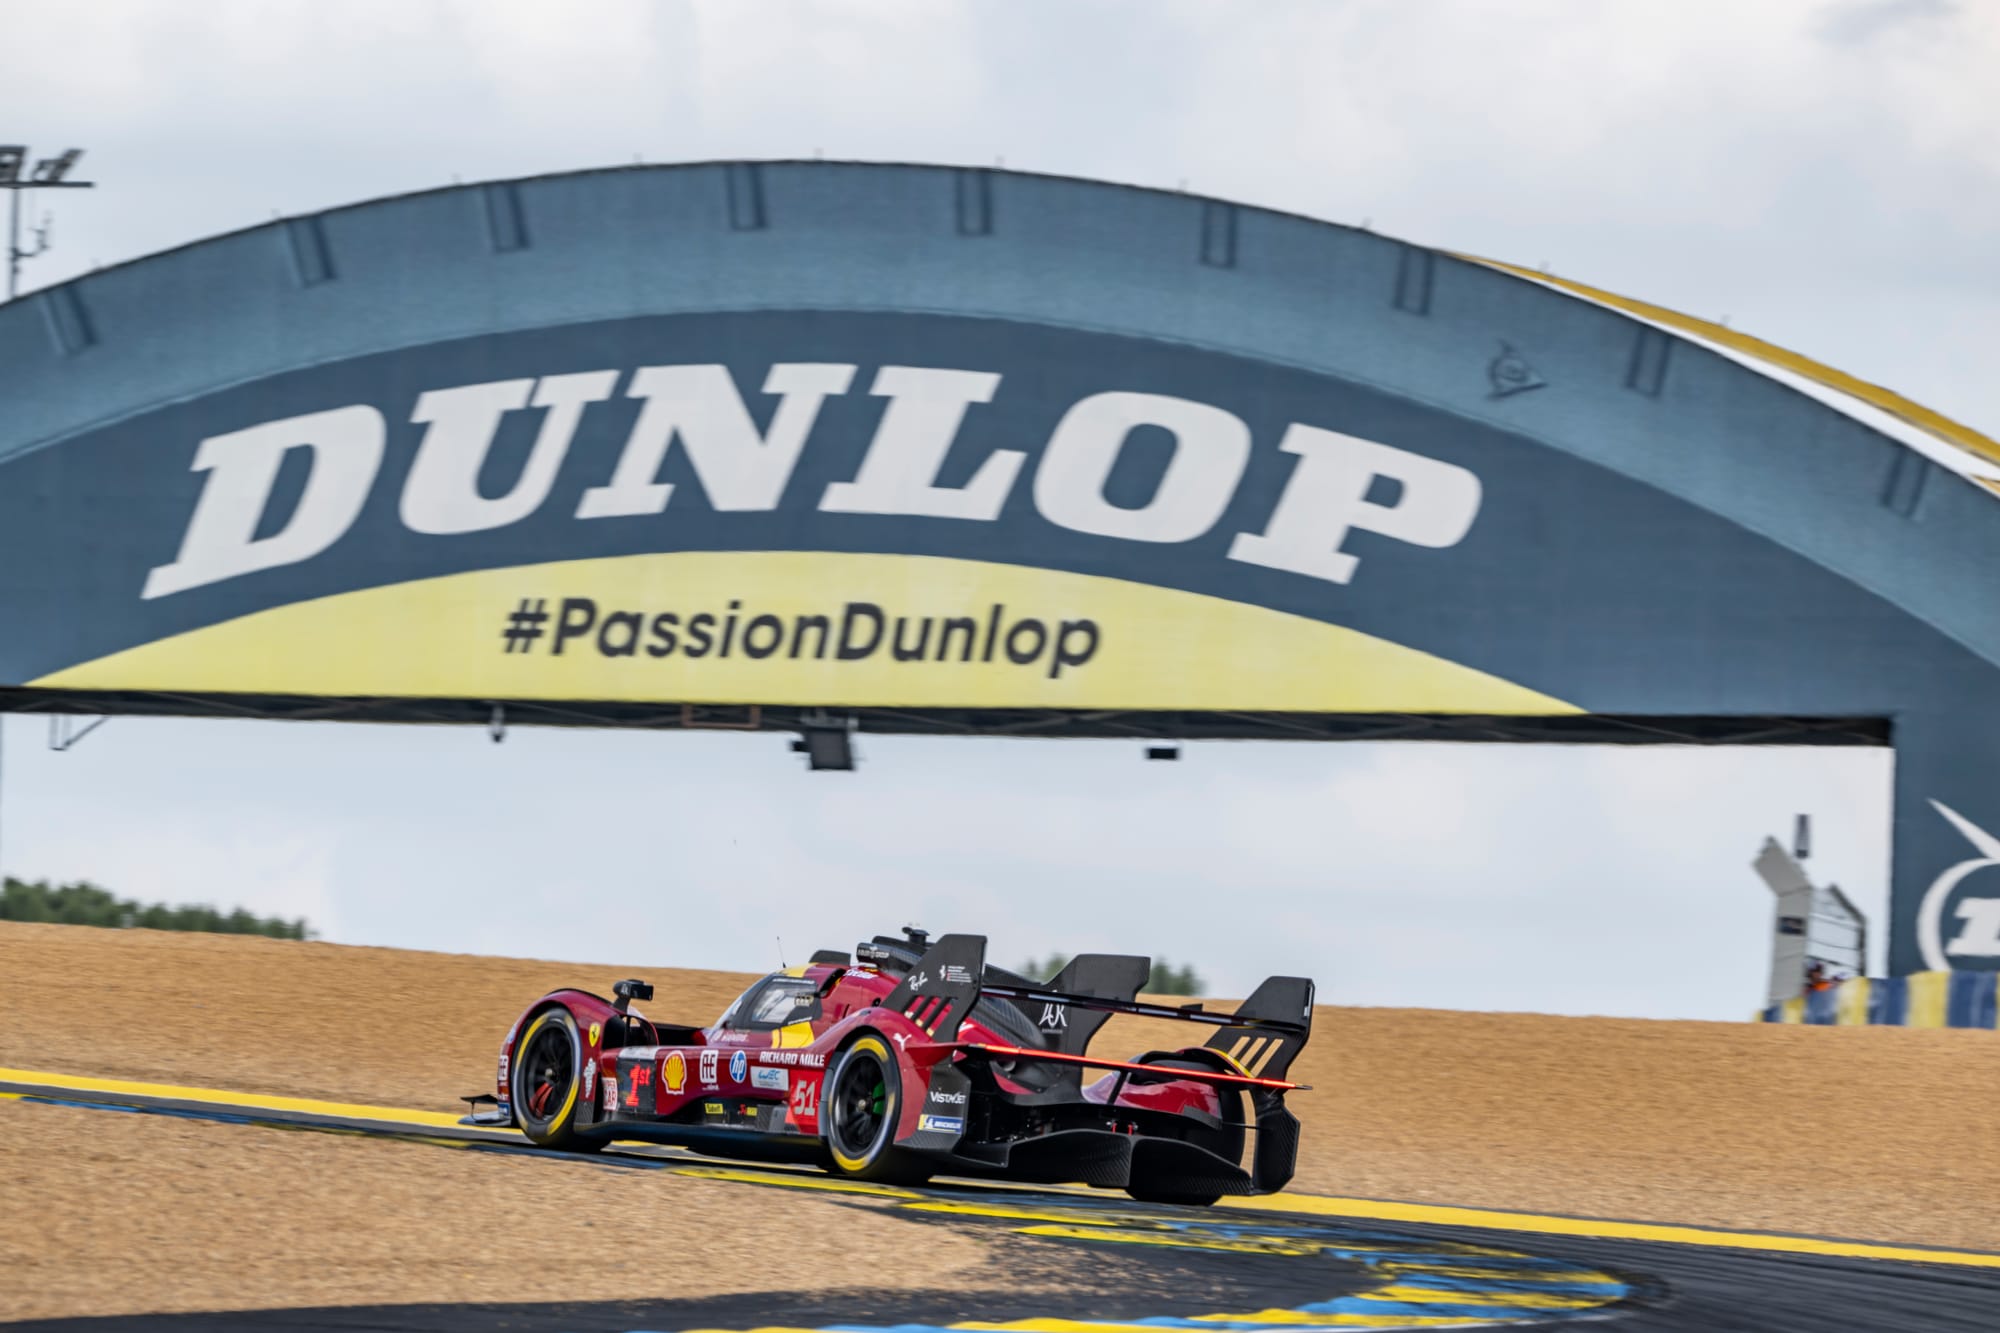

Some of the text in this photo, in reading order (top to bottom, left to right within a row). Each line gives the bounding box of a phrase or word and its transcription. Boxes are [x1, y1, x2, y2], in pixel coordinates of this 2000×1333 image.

[142, 363, 1482, 600] DUNLOP
[502, 598, 1101, 679] #PassionDunlop
[731, 1050, 746, 1083] hp
[760, 1051, 825, 1067] RICHARD MILLE
[625, 1064, 651, 1107] 1st
[794, 1080, 816, 1116] 51
